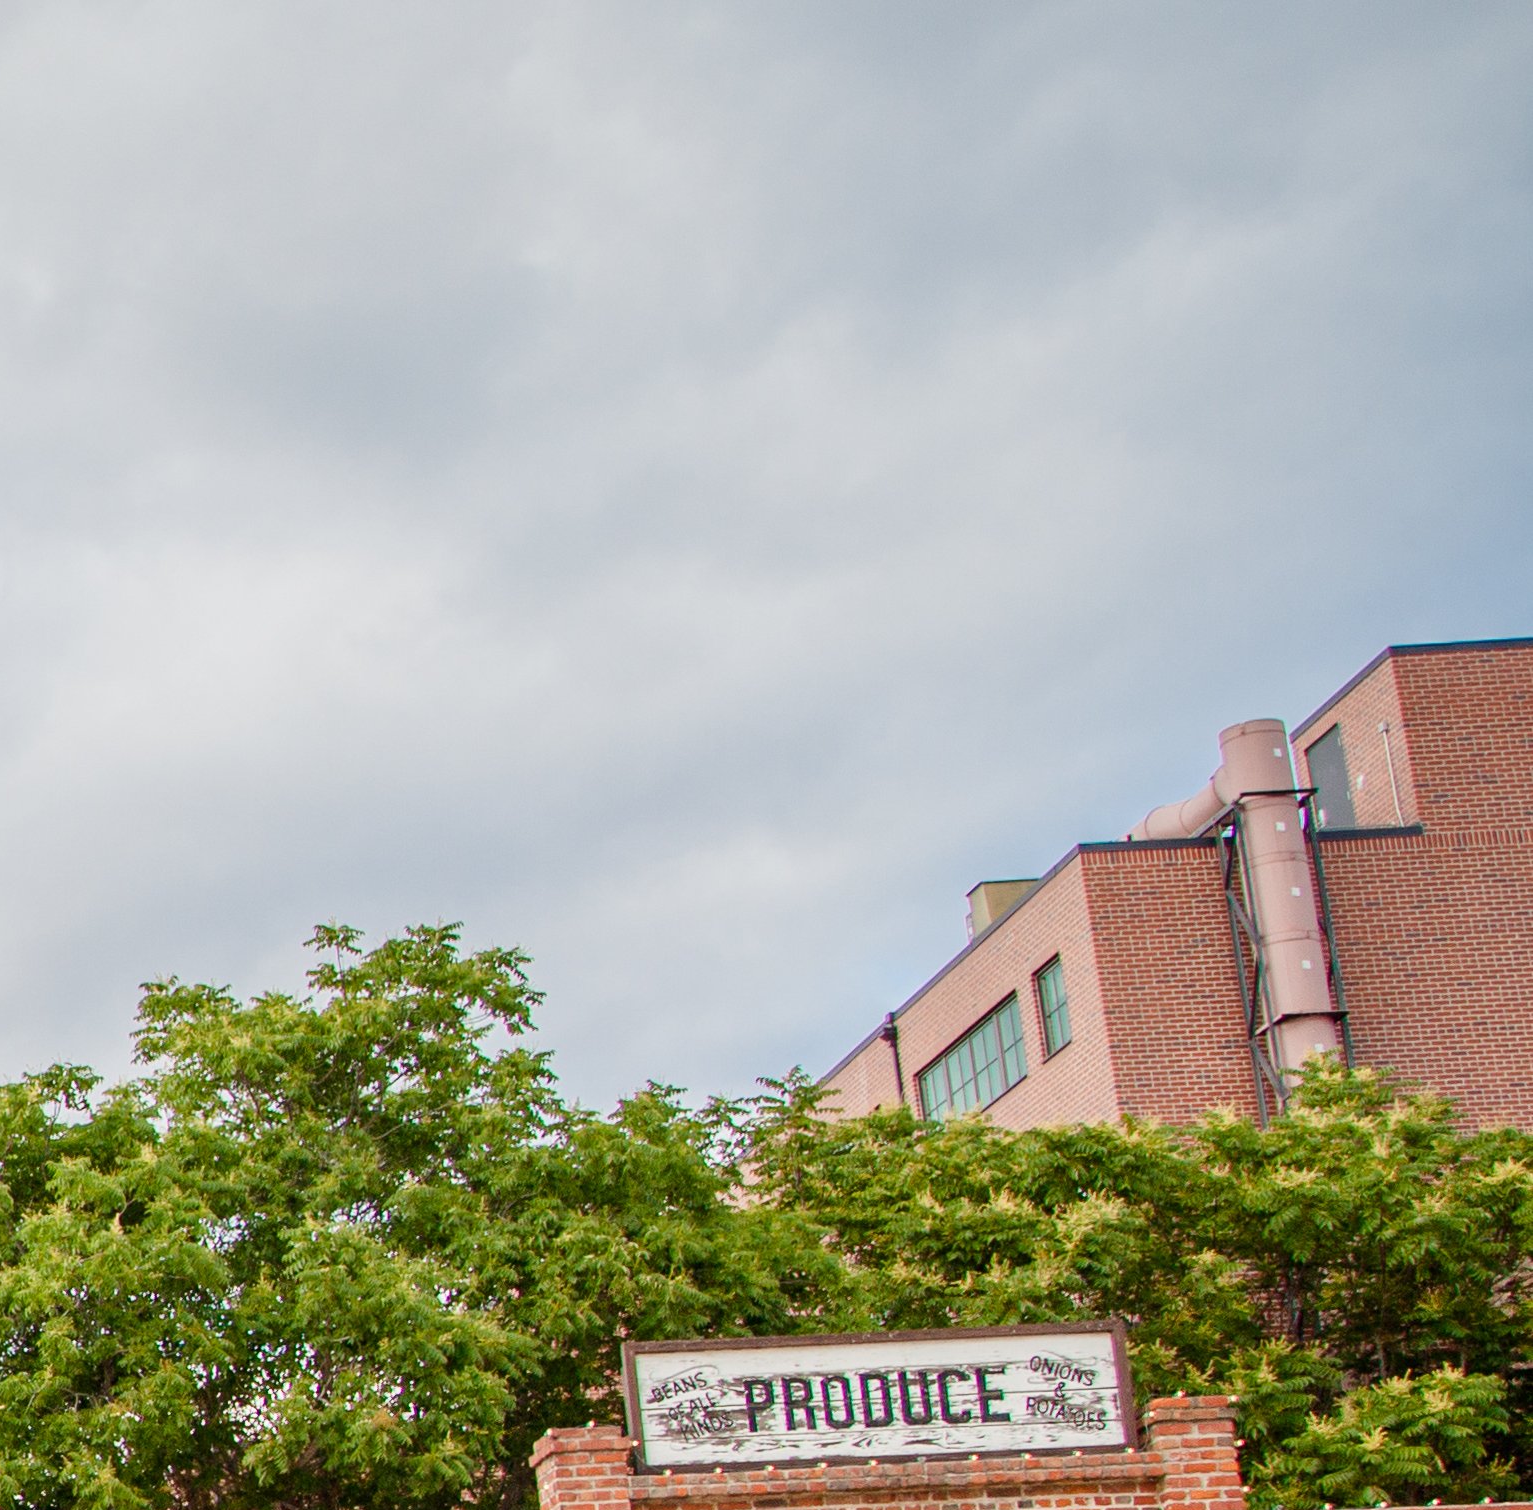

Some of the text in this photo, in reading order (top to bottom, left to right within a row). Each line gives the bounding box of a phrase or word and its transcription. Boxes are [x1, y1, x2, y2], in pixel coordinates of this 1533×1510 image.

[1029, 1355, 1096, 1387] ONIONS
[650, 1371, 708, 1403] BEANS
[743, 1367, 1012, 1433] PRODUCE
[1054, 1381, 1066, 1399] &
[689, 1391, 719, 1415] ALL
[679, 1414, 734, 1443] KINDS
